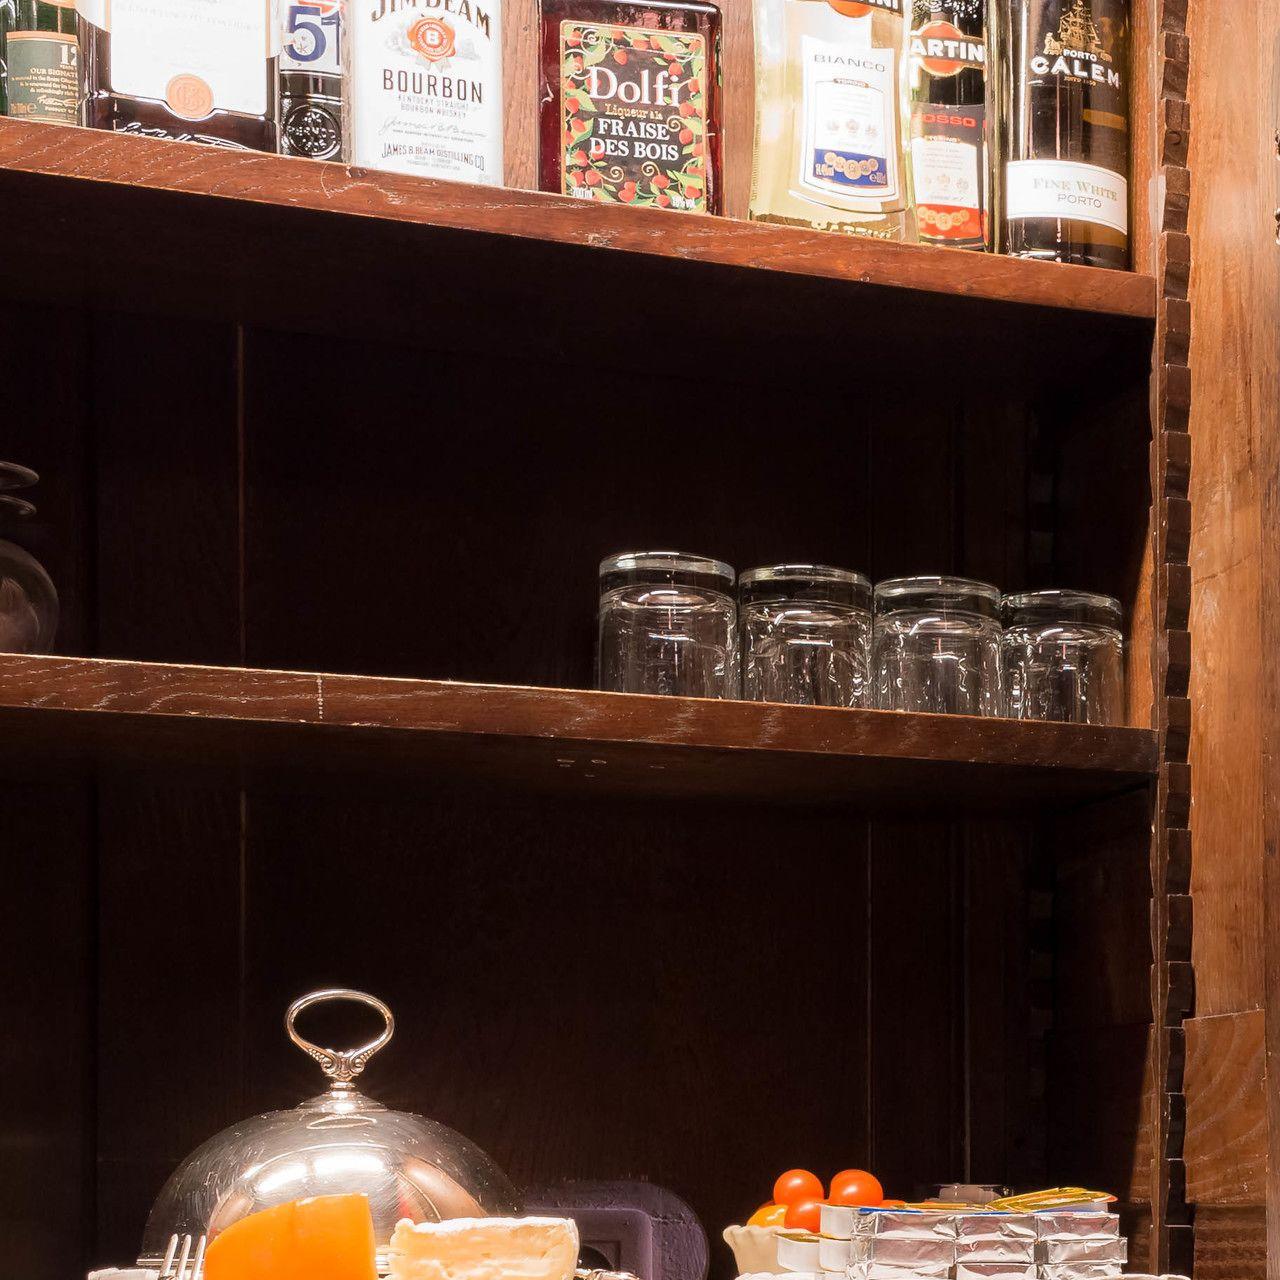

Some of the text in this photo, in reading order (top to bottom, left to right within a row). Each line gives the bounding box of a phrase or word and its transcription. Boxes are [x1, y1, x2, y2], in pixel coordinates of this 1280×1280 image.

[910, 38, 985, 62] ARTIN
[1063, 48, 1098, 62] PORTO
[814, 54, 886, 72] BIANCO
[383, 69, 483, 104] BOURBON
[586, 66, 681, 107] Dolfi
[604, 103, 648, 120] Liqueur
[598, 118, 670, 141] FRAISE
[590, 138, 680, 161] DES BOIS
[1034, 176, 1118, 201] FINE WHITE
[1058, 193, 1102, 208] PORTO
